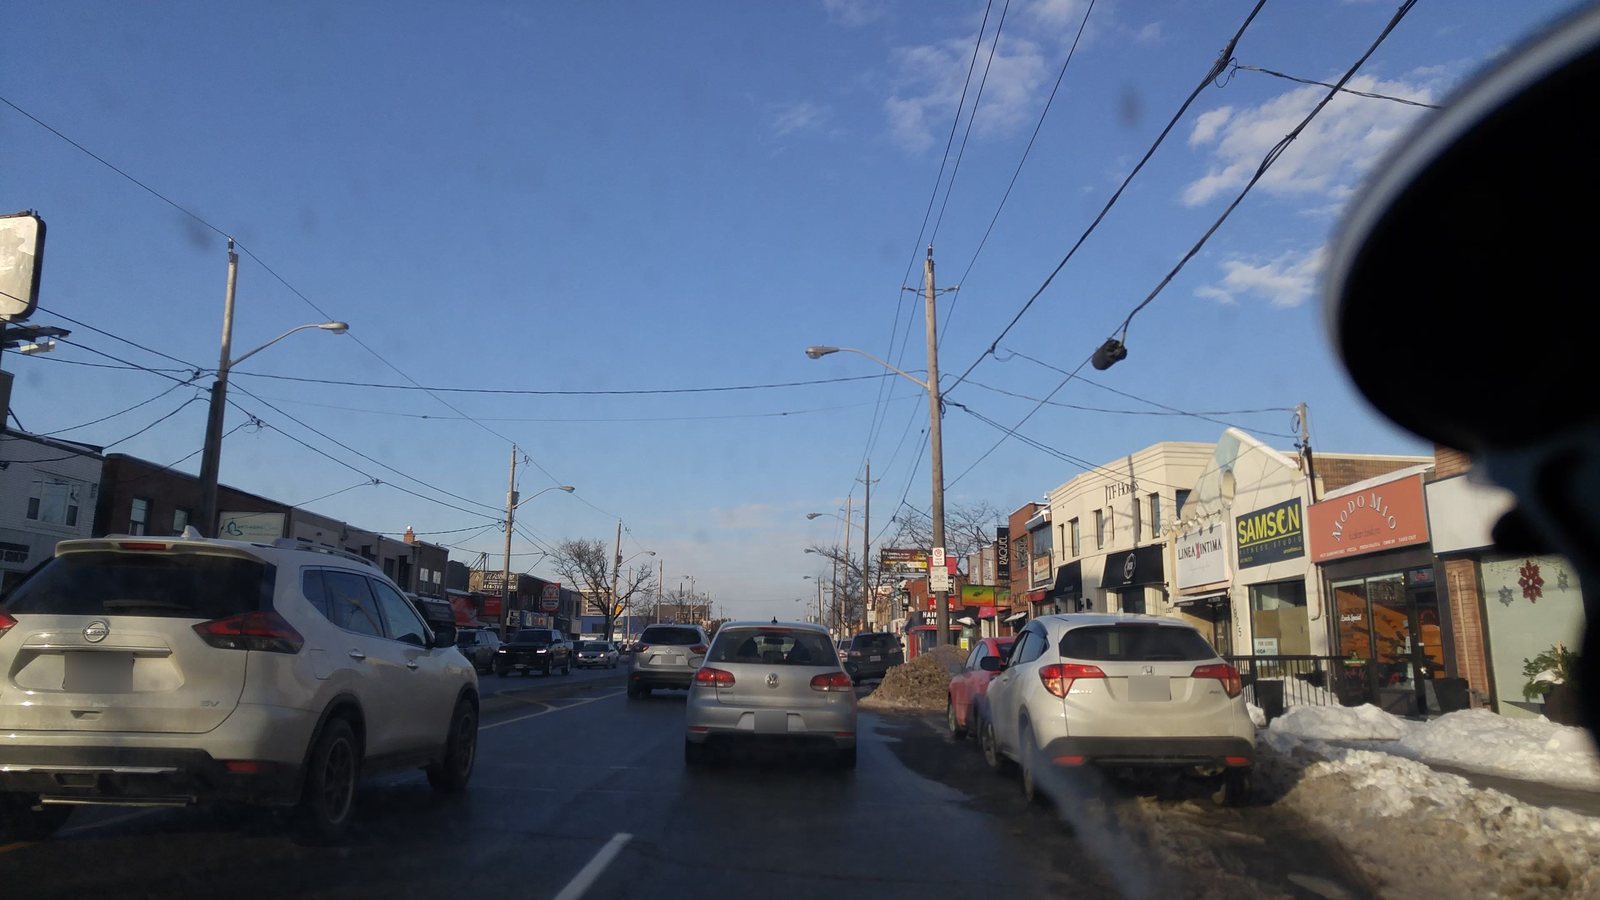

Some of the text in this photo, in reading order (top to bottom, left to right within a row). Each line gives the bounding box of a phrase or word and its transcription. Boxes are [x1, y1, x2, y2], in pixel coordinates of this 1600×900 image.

[1238, 504, 1300, 544] SAMSON
[1332, 493, 1397, 542] MODO MIO
[1178, 539, 1222, 560] LINEA INTIMA
